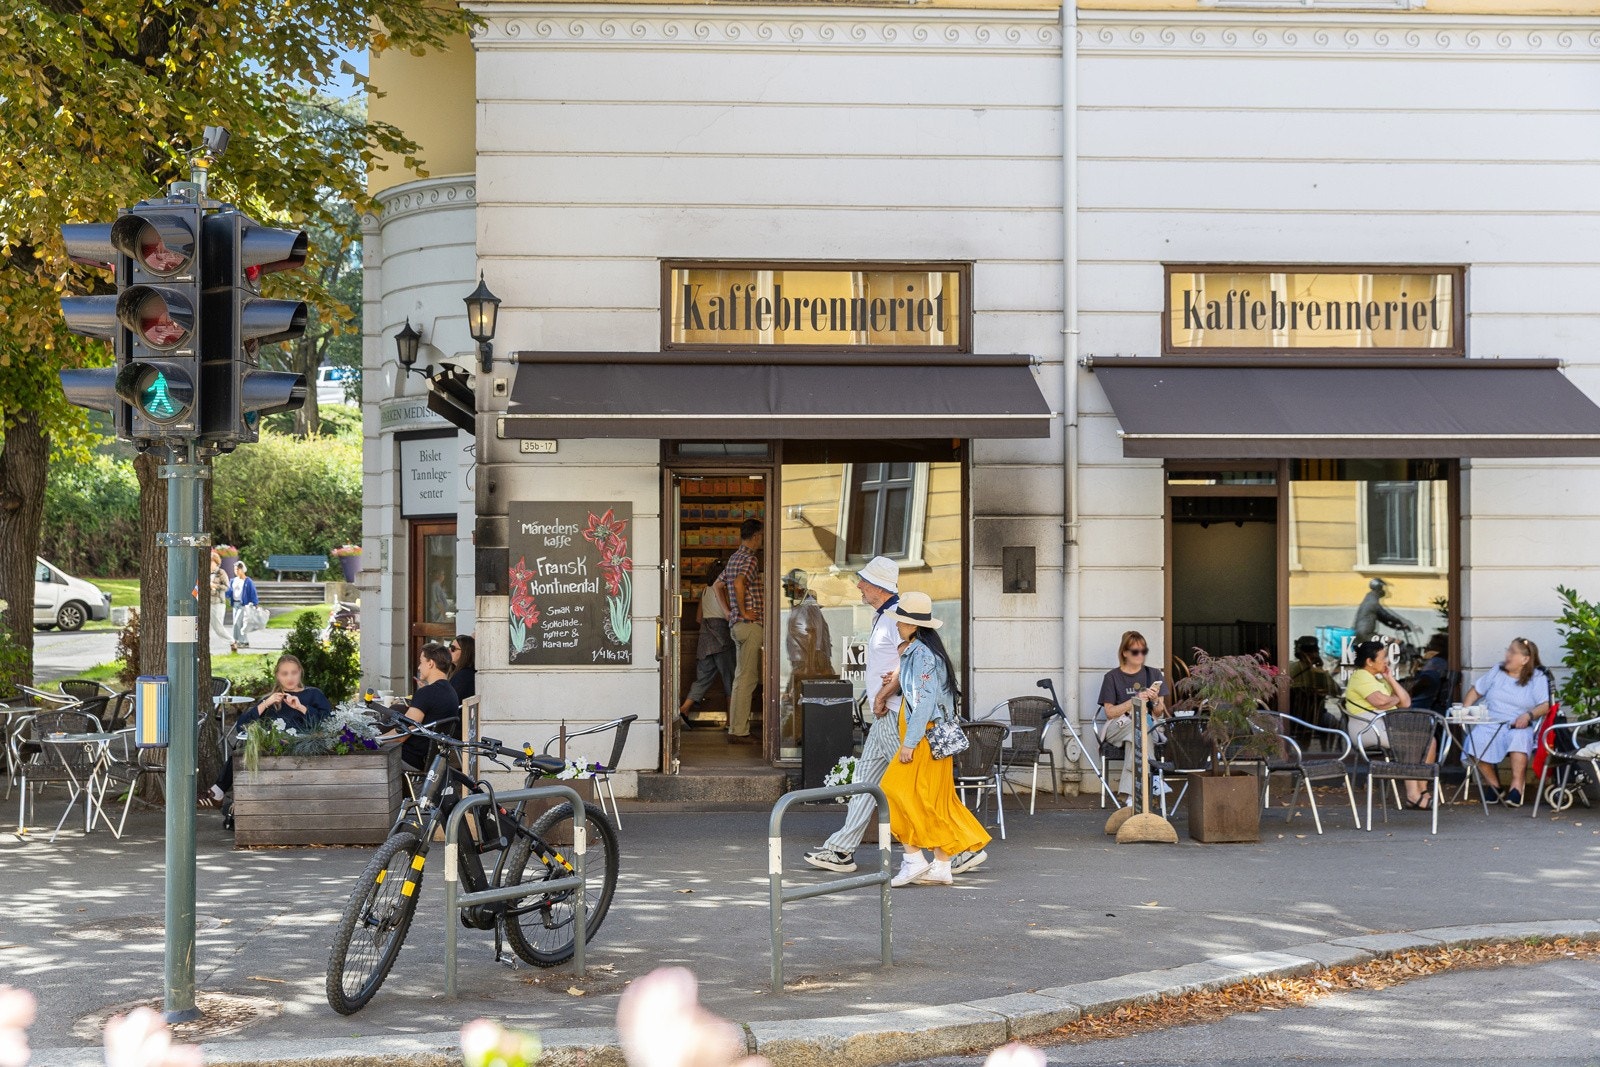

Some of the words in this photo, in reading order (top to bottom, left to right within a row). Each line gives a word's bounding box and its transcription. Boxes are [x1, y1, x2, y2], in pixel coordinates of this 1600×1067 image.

[683, 283, 949, 332] Kaffebrenneriet
[1182, 289, 1442, 331] Kaffebrenneriet
[419, 450, 442, 462] Bislet
[411, 468, 452, 483] Tannlege-
[419, 490, 444, 499] senter
[530, 577, 599, 595] Kontinental
[571, 628, 580, 638] &
